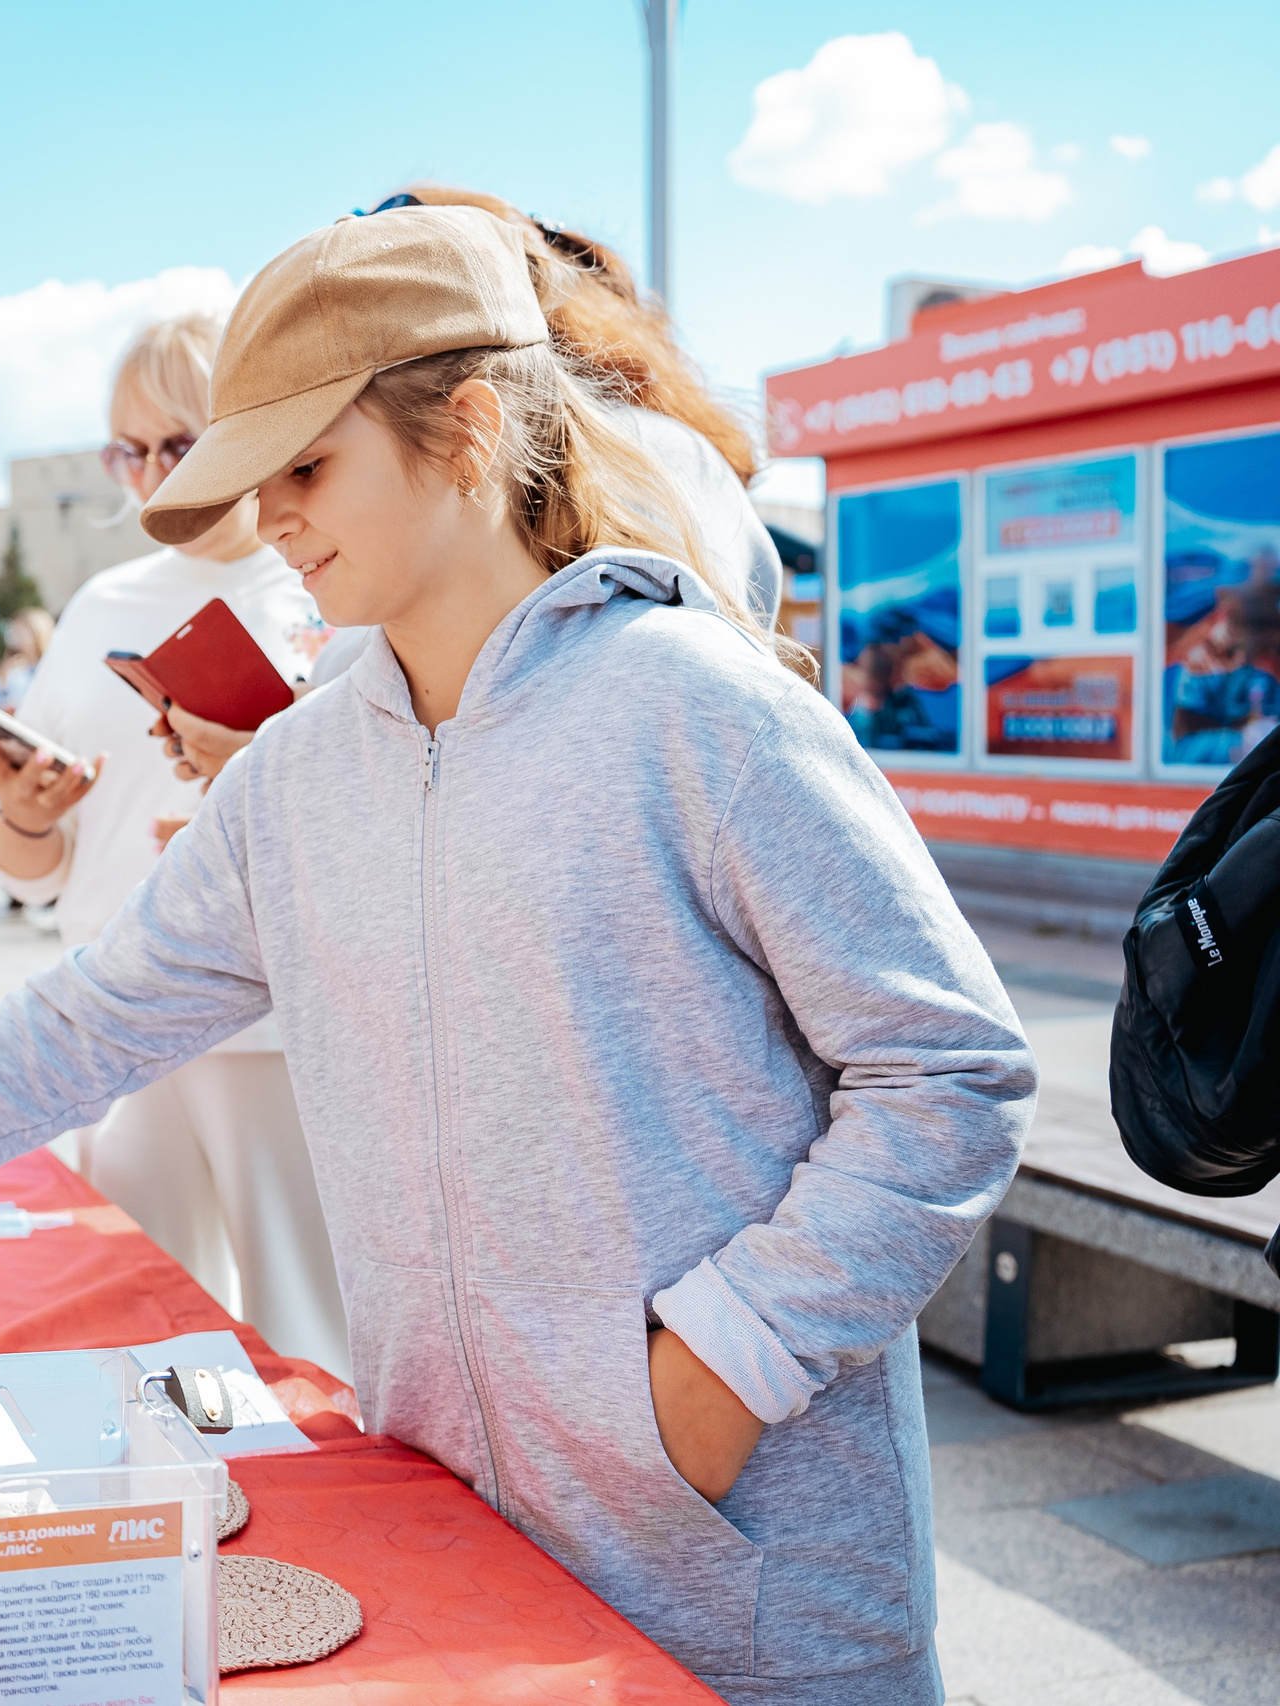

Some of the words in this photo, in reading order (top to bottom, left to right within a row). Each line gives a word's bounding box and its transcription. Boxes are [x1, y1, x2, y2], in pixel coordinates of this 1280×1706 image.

[1187, 897, 1217, 951] Monique
[1208, 948, 1223, 967] Le
[107, 1517, 166, 1543] ЛИС
